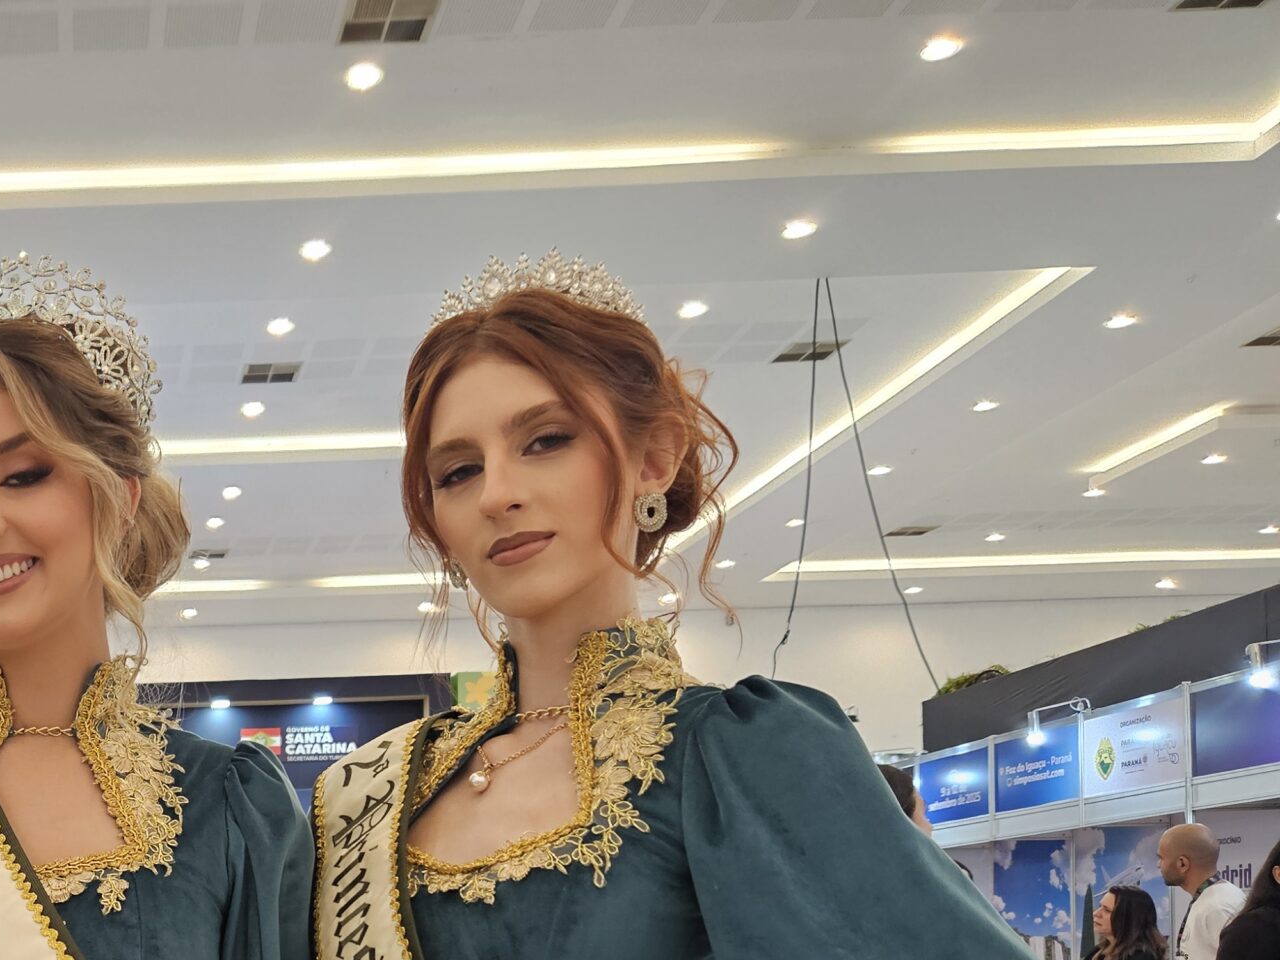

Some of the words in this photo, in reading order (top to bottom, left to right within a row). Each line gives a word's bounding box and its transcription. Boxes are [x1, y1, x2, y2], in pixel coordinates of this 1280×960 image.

[285, 732, 333, 744] SANTA
[285, 742, 358, 755] CATARINA
[1220, 863, 1252, 889] drid
